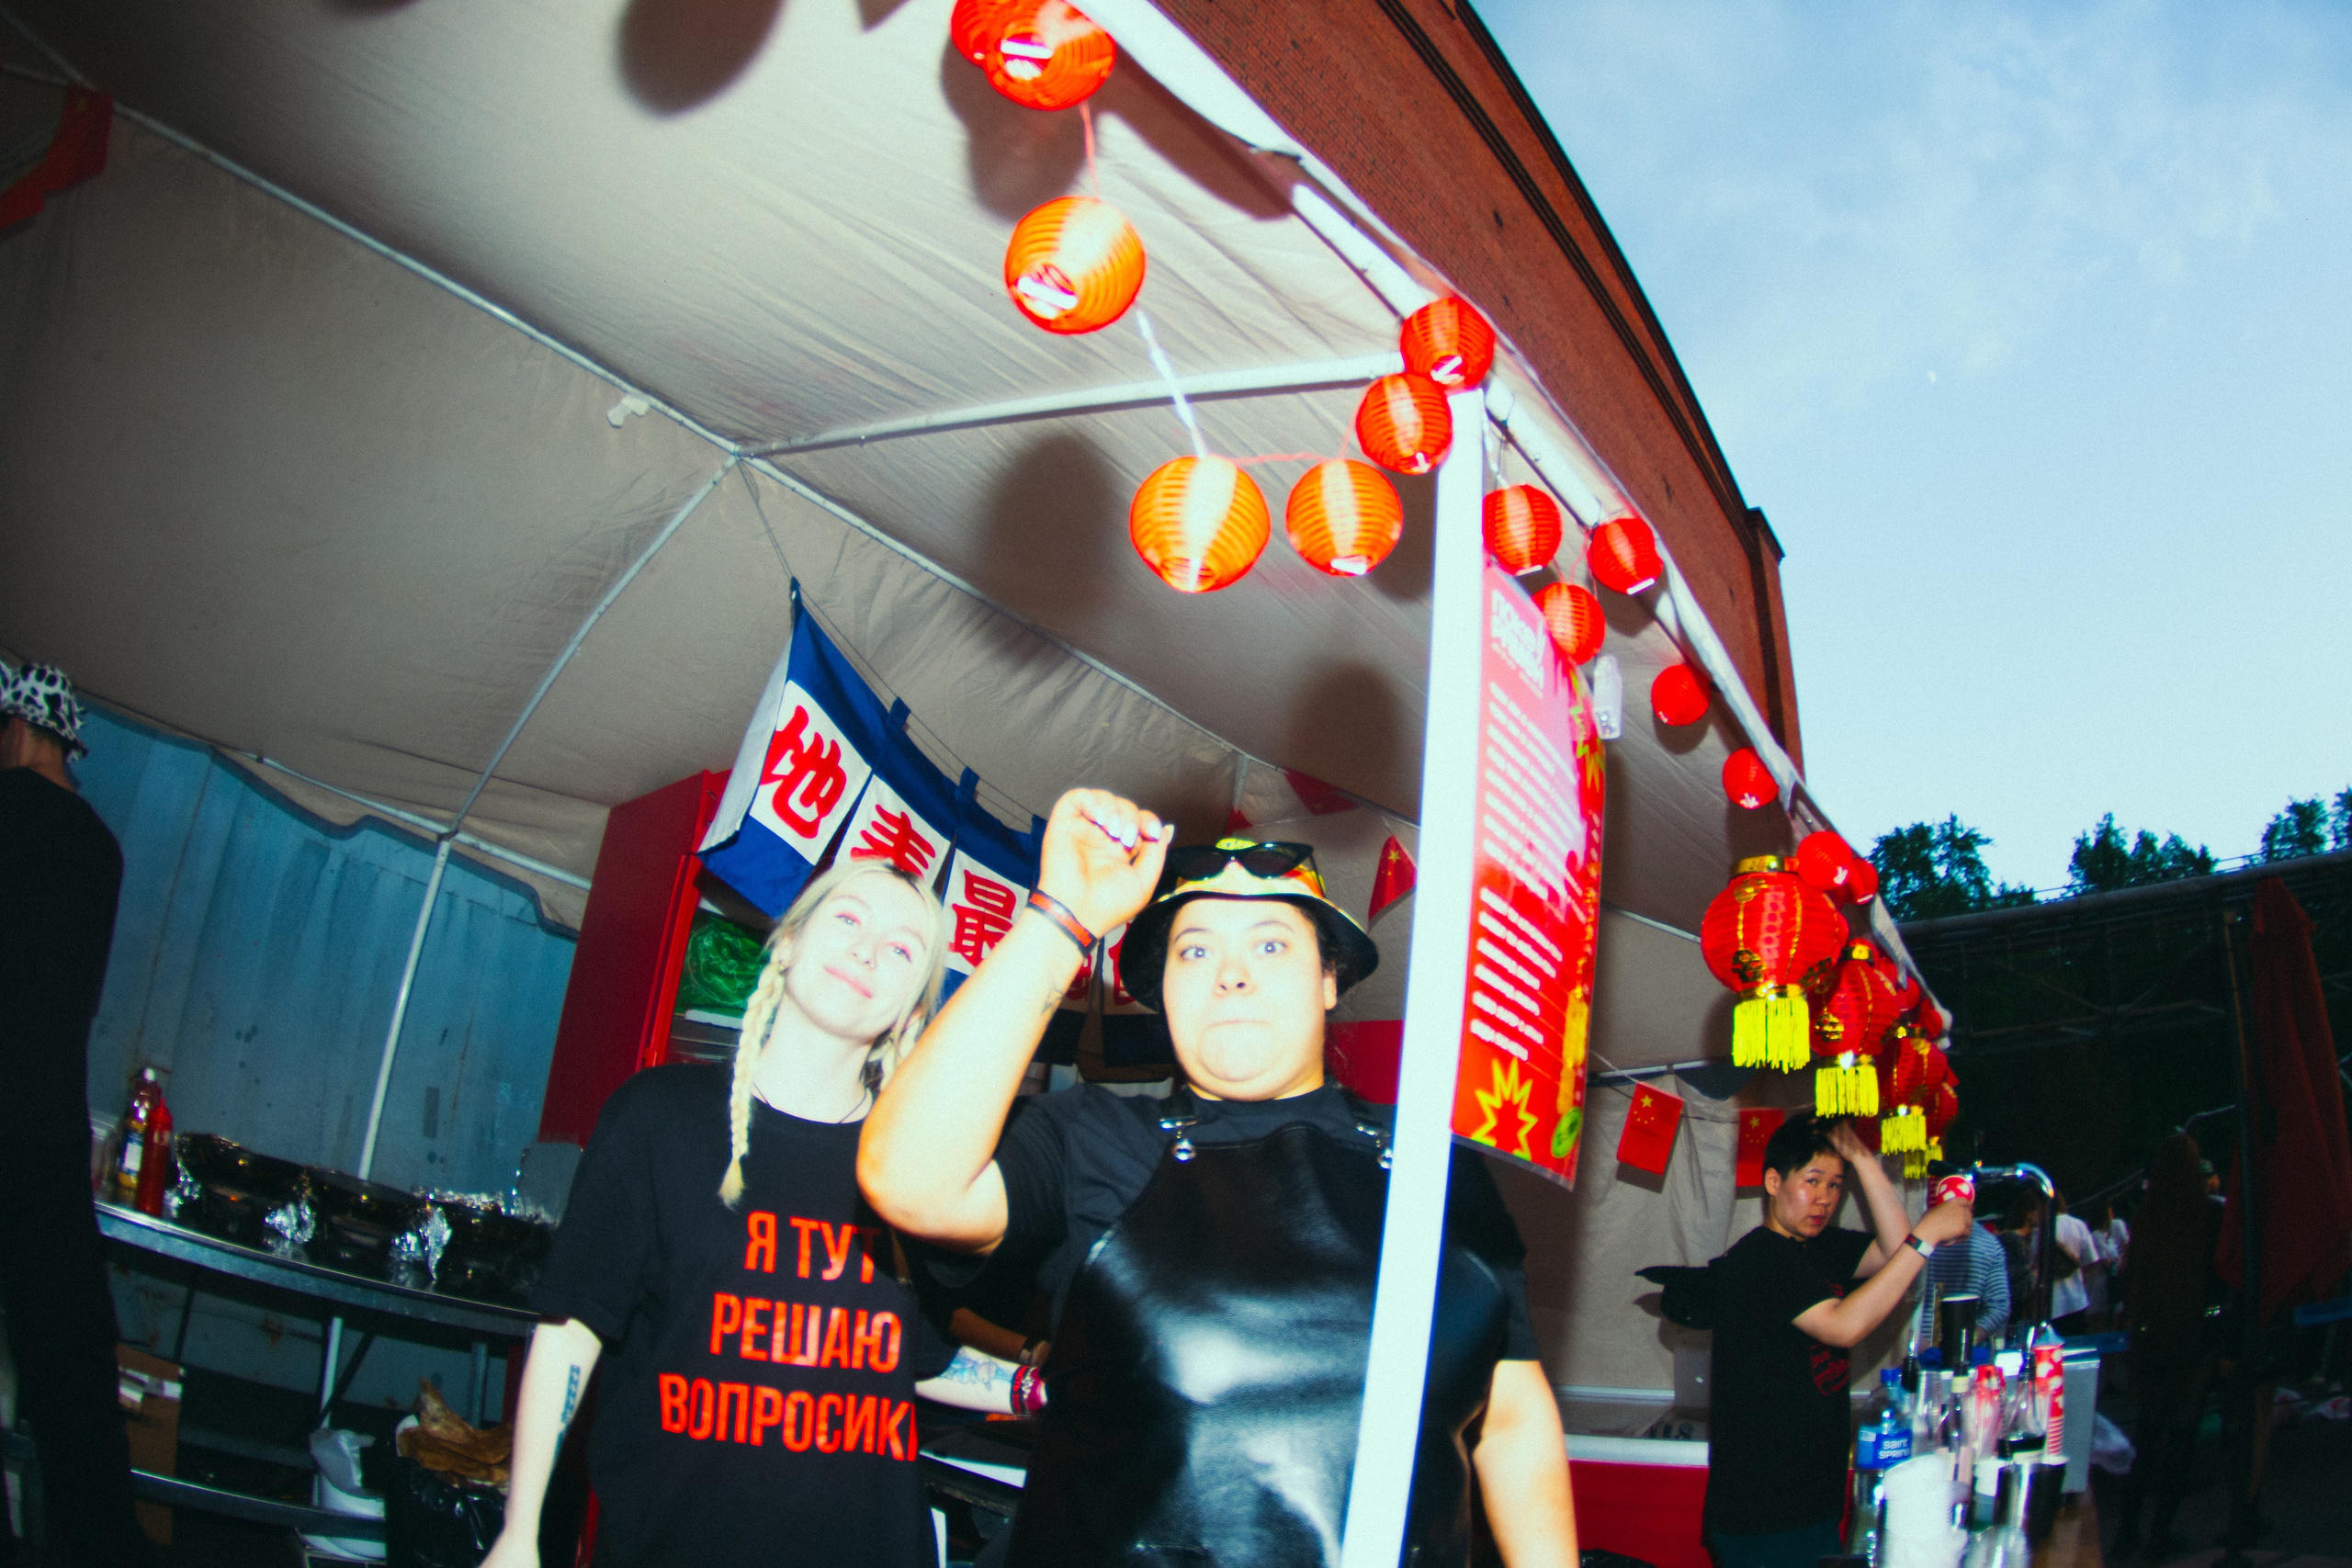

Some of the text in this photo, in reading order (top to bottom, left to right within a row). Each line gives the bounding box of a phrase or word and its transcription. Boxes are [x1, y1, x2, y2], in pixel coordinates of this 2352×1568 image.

[744, 1210, 883, 1284] Я ТУТ
[709, 1292, 902, 1373] РЕШАЮ
